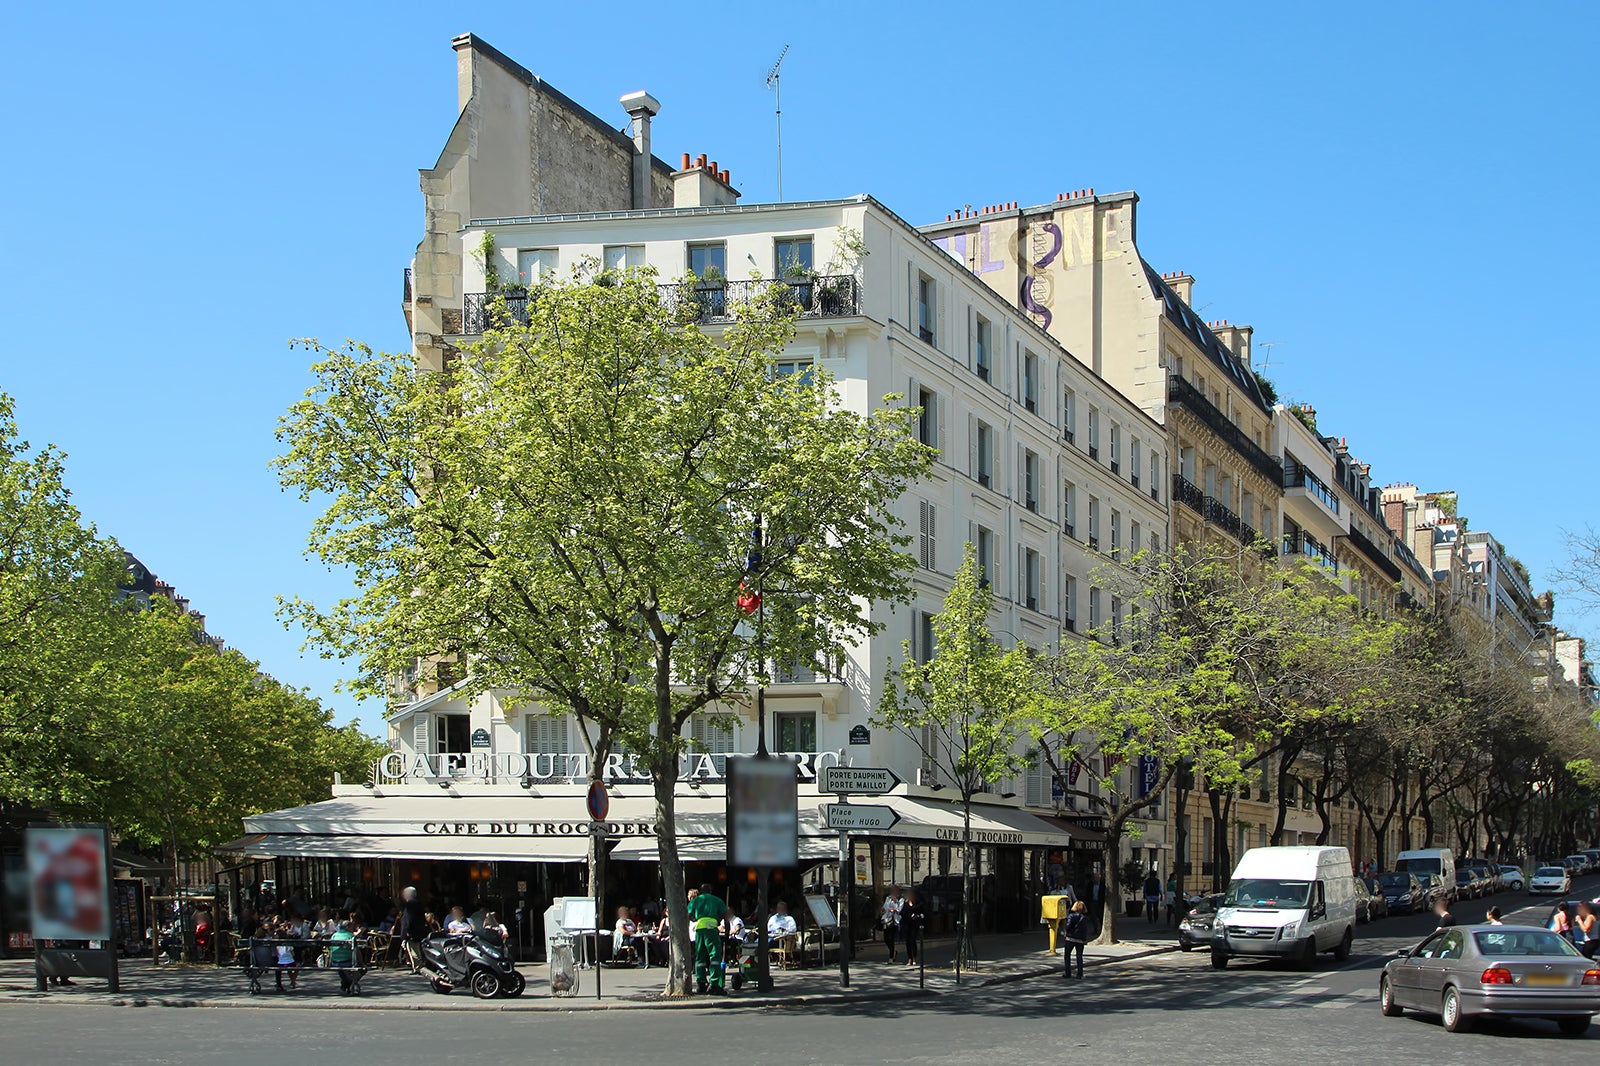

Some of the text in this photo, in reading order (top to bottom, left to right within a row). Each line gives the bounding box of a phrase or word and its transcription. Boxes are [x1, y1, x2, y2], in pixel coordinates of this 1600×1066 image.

[380, 752, 839, 779] CAFE DU TRARO
[1070, 761, 1078, 782] ABAC
[1143, 744, 1154, 793] OTEL
[829, 771, 887, 780] PORTE DAUPHINE
[856, 781, 887, 789] MAILLOT
[831, 807, 852, 816] Place
[831, 817, 880, 826] Victor HUGO
[423, 822, 658, 834] CAFE DU TROCDER
[936, 828, 959, 840] CAFE
[976, 831, 1023, 843] TROCADERO
